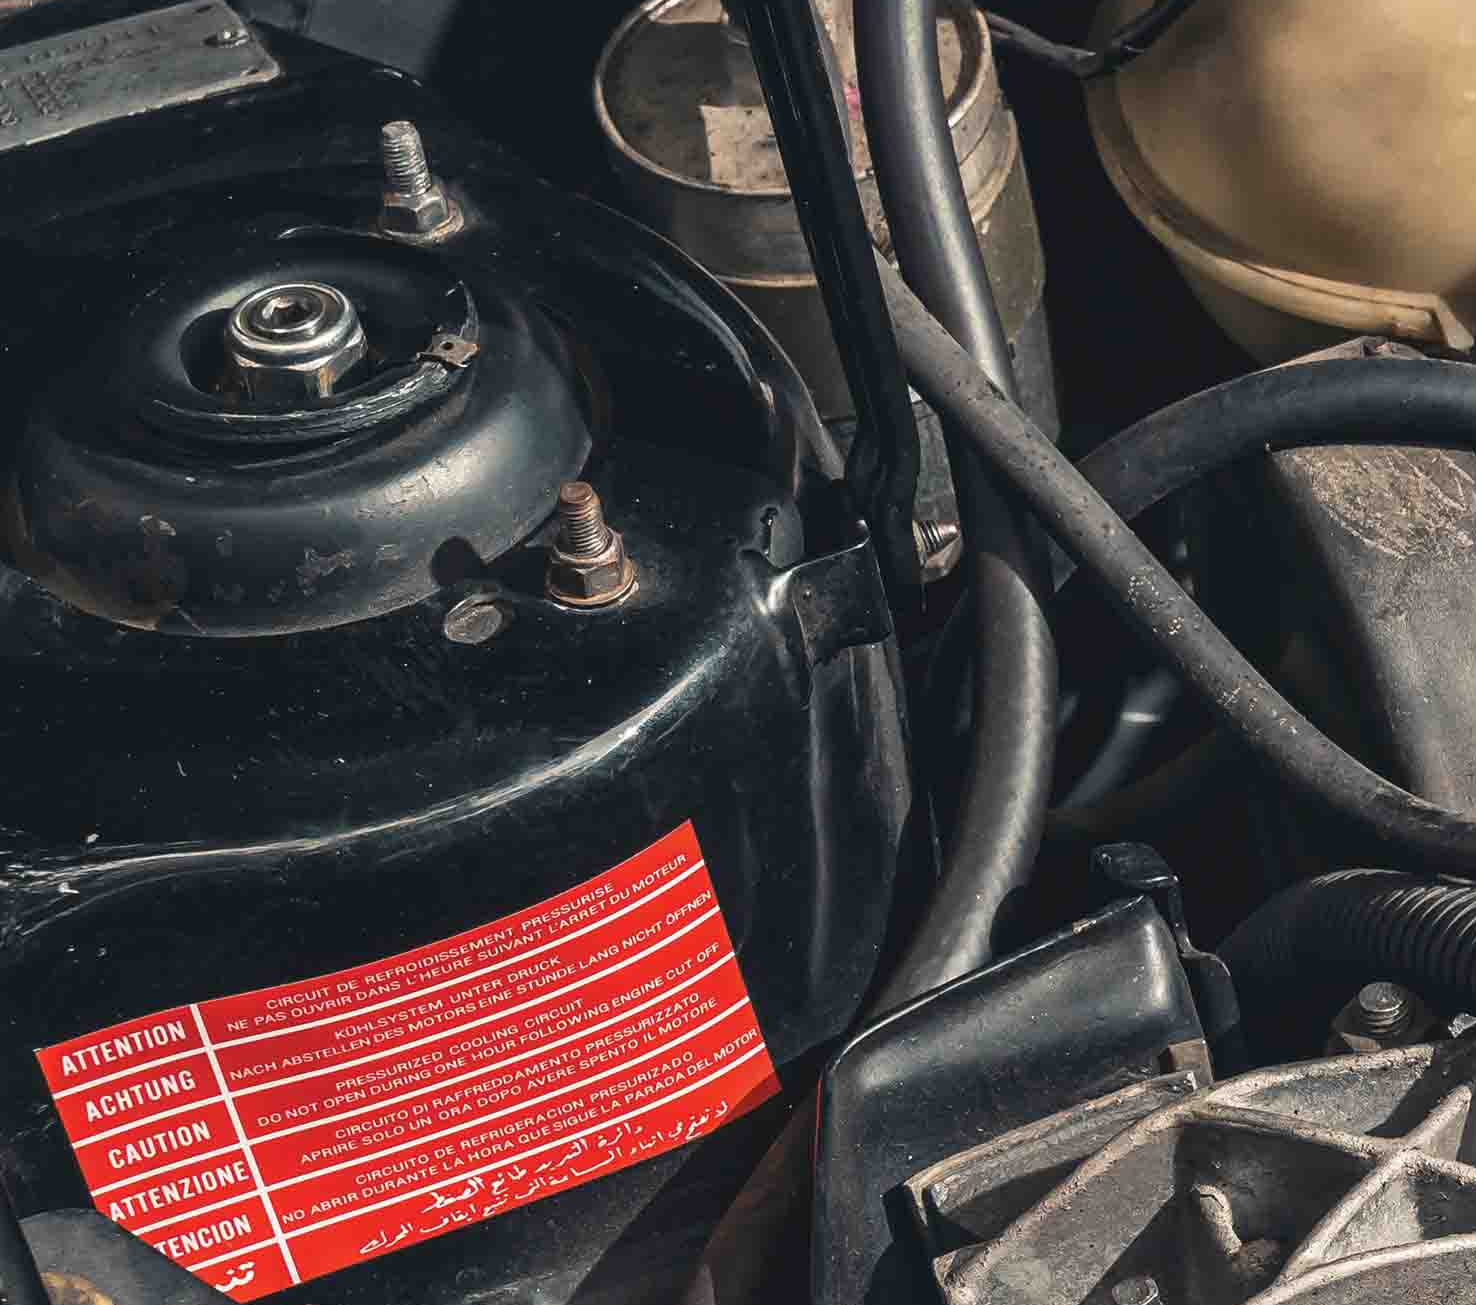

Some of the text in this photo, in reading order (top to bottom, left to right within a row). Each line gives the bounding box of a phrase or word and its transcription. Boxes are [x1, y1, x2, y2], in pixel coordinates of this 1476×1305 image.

[228, 854, 686, 1031] NE PAS OUVRIR DANS L'HEURE SUIVANT L'ARRET DU MOTEUR
[230, 890, 711, 1080] NACH ABSTELLEN DES MOTORS EINE STUNDE LANG NICHT ÖFFNEN
[266, 884, 613, 1009] CIRCUIT DE REFROIDISSEMENT PRESSURISE
[335, 956, 560, 1039] KÜHLSYSTEM UNTER DRUCK
[62, 1021, 186, 1076] ATTENTION
[85, 1070, 195, 1122] ACHTUNG
[258, 942, 718, 1126] DO NOT OPEN DURING ONE HOUR FOLLOWING ENGINE CUT OFF
[302, 998, 716, 1163] APRIRE SOLO UN ORA DOPO AVERE SPENTO IL MOTORE
[336, 999, 582, 1090] PRESSURIZED COOLING CIRCUIT
[336, 993, 699, 1138] CIRCUITO DI RAFFREDDAMENTO PRESSURIZZATO
[108, 1121, 210, 1168] CAUTION
[282, 1028, 757, 1224] NO ABRIR DURANTE LA HORA QUE SIGUE LA PARADA DEL MOTOR
[356, 1052, 692, 1184] CIRCUITO DE REFRIGERACION PRESURIZADO
[110, 1161, 249, 1222] ATTENZIONE
[153, 1215, 251, 1259] TENCION
